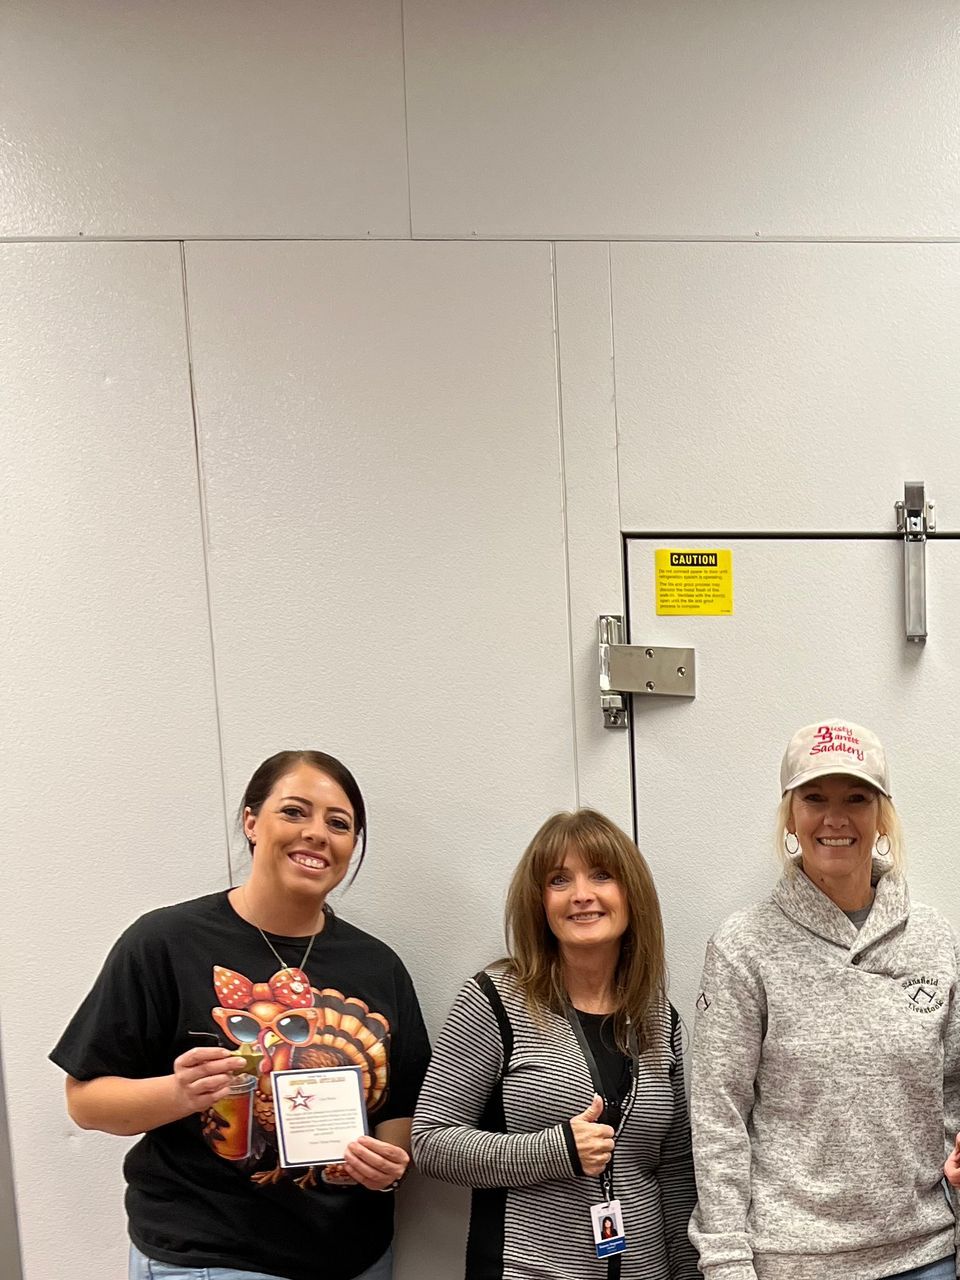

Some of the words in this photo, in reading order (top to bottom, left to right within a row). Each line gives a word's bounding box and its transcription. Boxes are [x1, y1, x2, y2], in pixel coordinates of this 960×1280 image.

[672, 554, 716, 564] CAUTION
[810, 743, 864, 761] Saddlery
[902, 976, 938, 990] Stanfield
